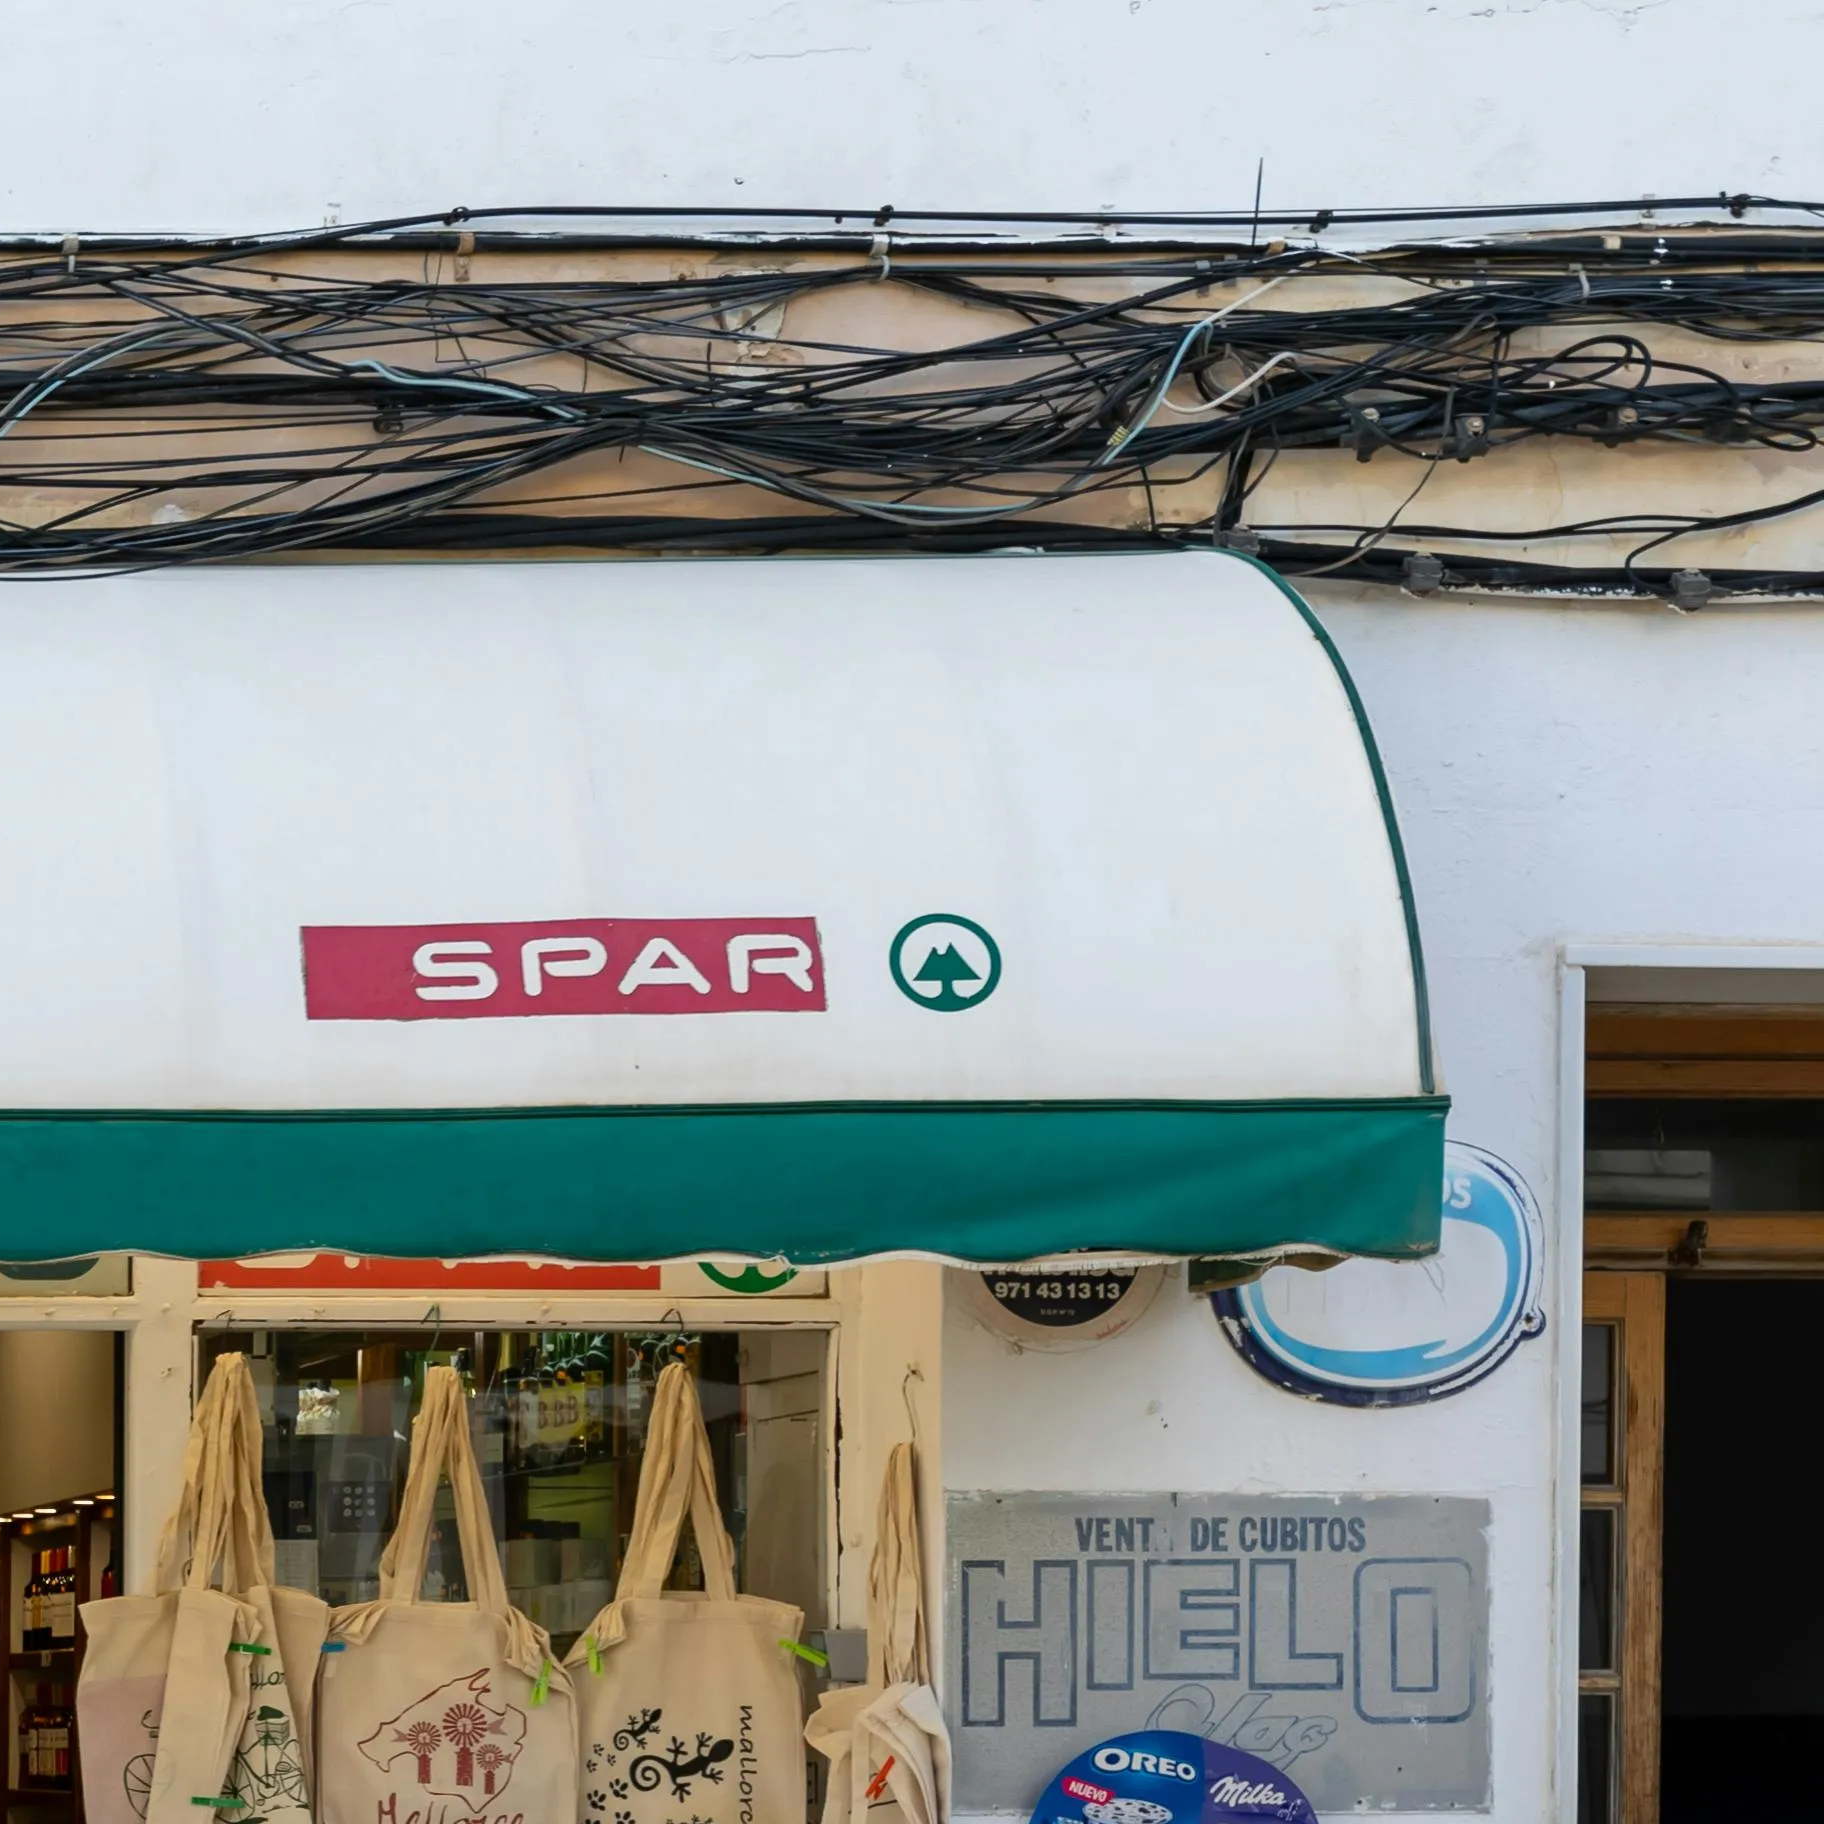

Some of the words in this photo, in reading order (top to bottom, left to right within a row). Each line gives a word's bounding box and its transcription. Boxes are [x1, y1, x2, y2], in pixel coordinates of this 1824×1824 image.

[413, 934, 814, 1001] SPAR
[995, 1282, 1030, 1298] 971
[1036, 1282, 1062, 1298] 43
[1067, 1282, 1091, 1298] 13
[1097, 1282, 1120, 1298] 13
[1075, 1517, 1175, 1553] VENT
[1191, 1517, 1228, 1553] DE
[1239, 1517, 1367, 1553] CUBITOS
[961, 1557, 1476, 1727] HIELO
[1094, 1747, 1197, 1781] OREO
[1068, 1781, 1108, 1803] NUEVO
[1210, 1775, 1287, 1807] Milka
